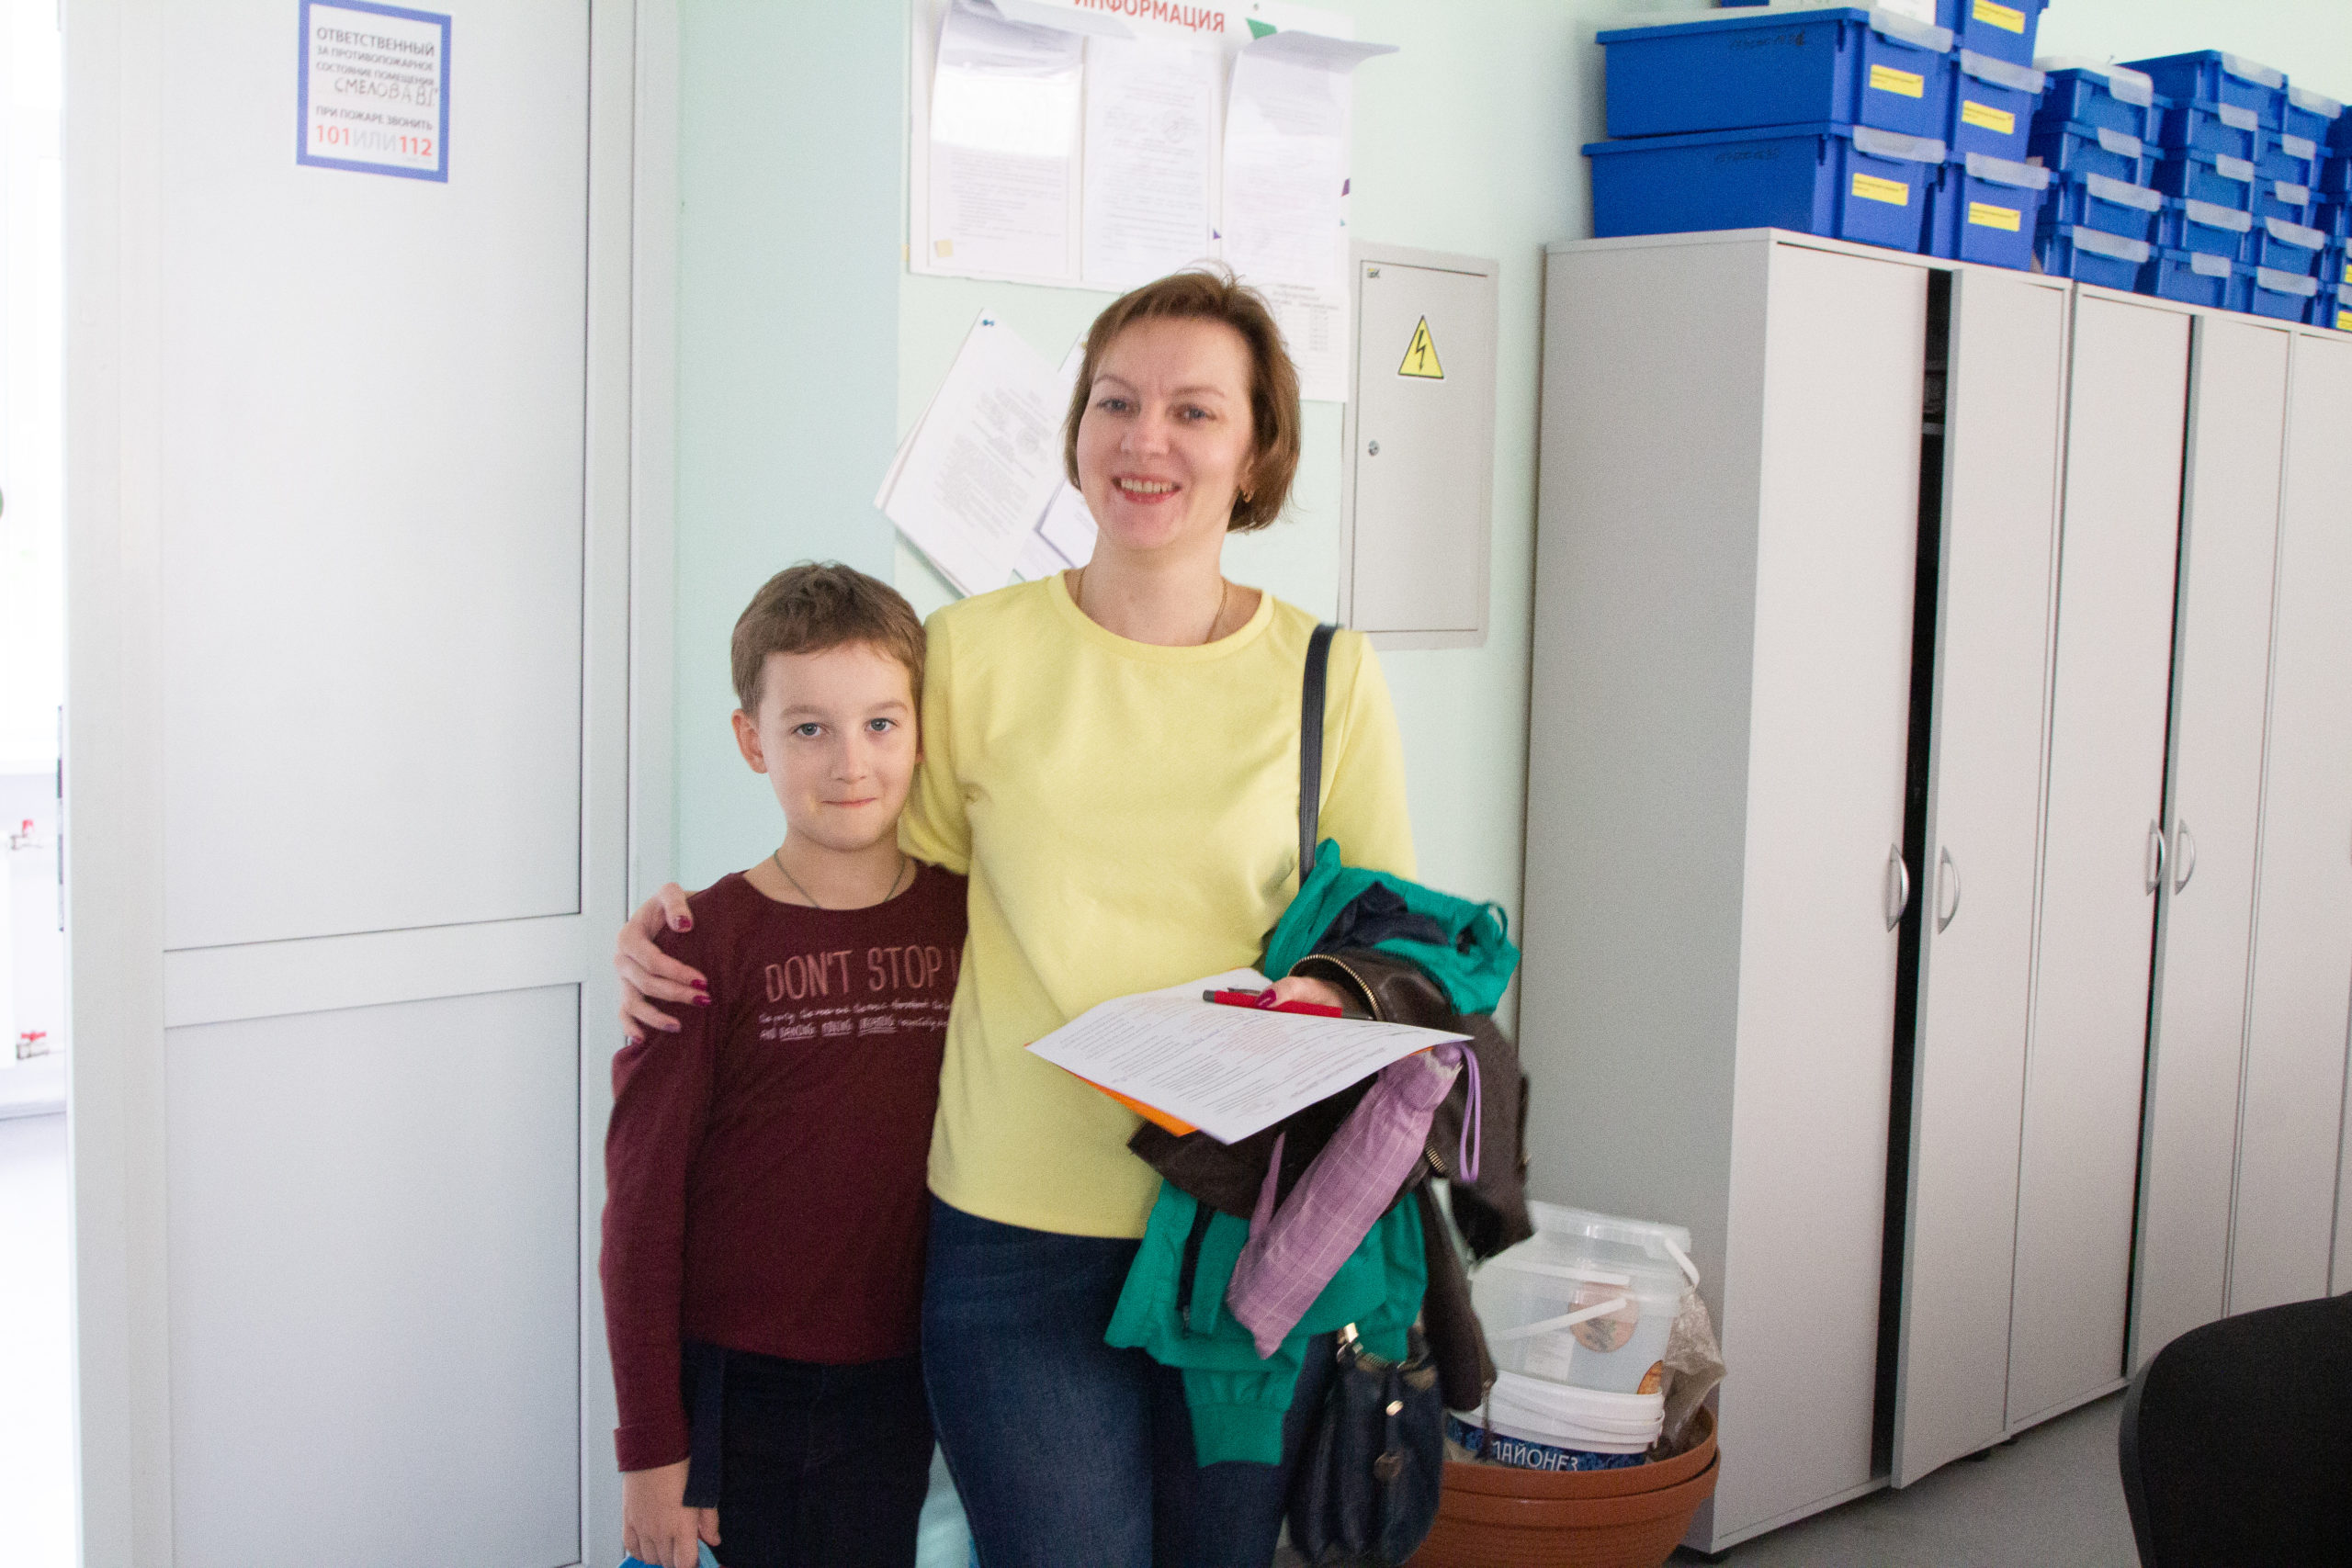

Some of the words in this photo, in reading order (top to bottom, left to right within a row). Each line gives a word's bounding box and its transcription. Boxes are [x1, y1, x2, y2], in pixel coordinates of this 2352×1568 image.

[317, 27, 435, 57] ОТВЕТСТВЕННЫЙ
[317, 45, 329, 55] ЗА
[316, 106, 338, 118] ПРИ
[387, 115, 433, 130] ЗВОНИТЬ
[317, 125, 349, 146] 101
[353, 130, 396, 152] ИЛИ
[400, 135, 433, 156] 112
[764, 949, 853, 1003] DON'T
[867, 945, 943, 992] STOP
